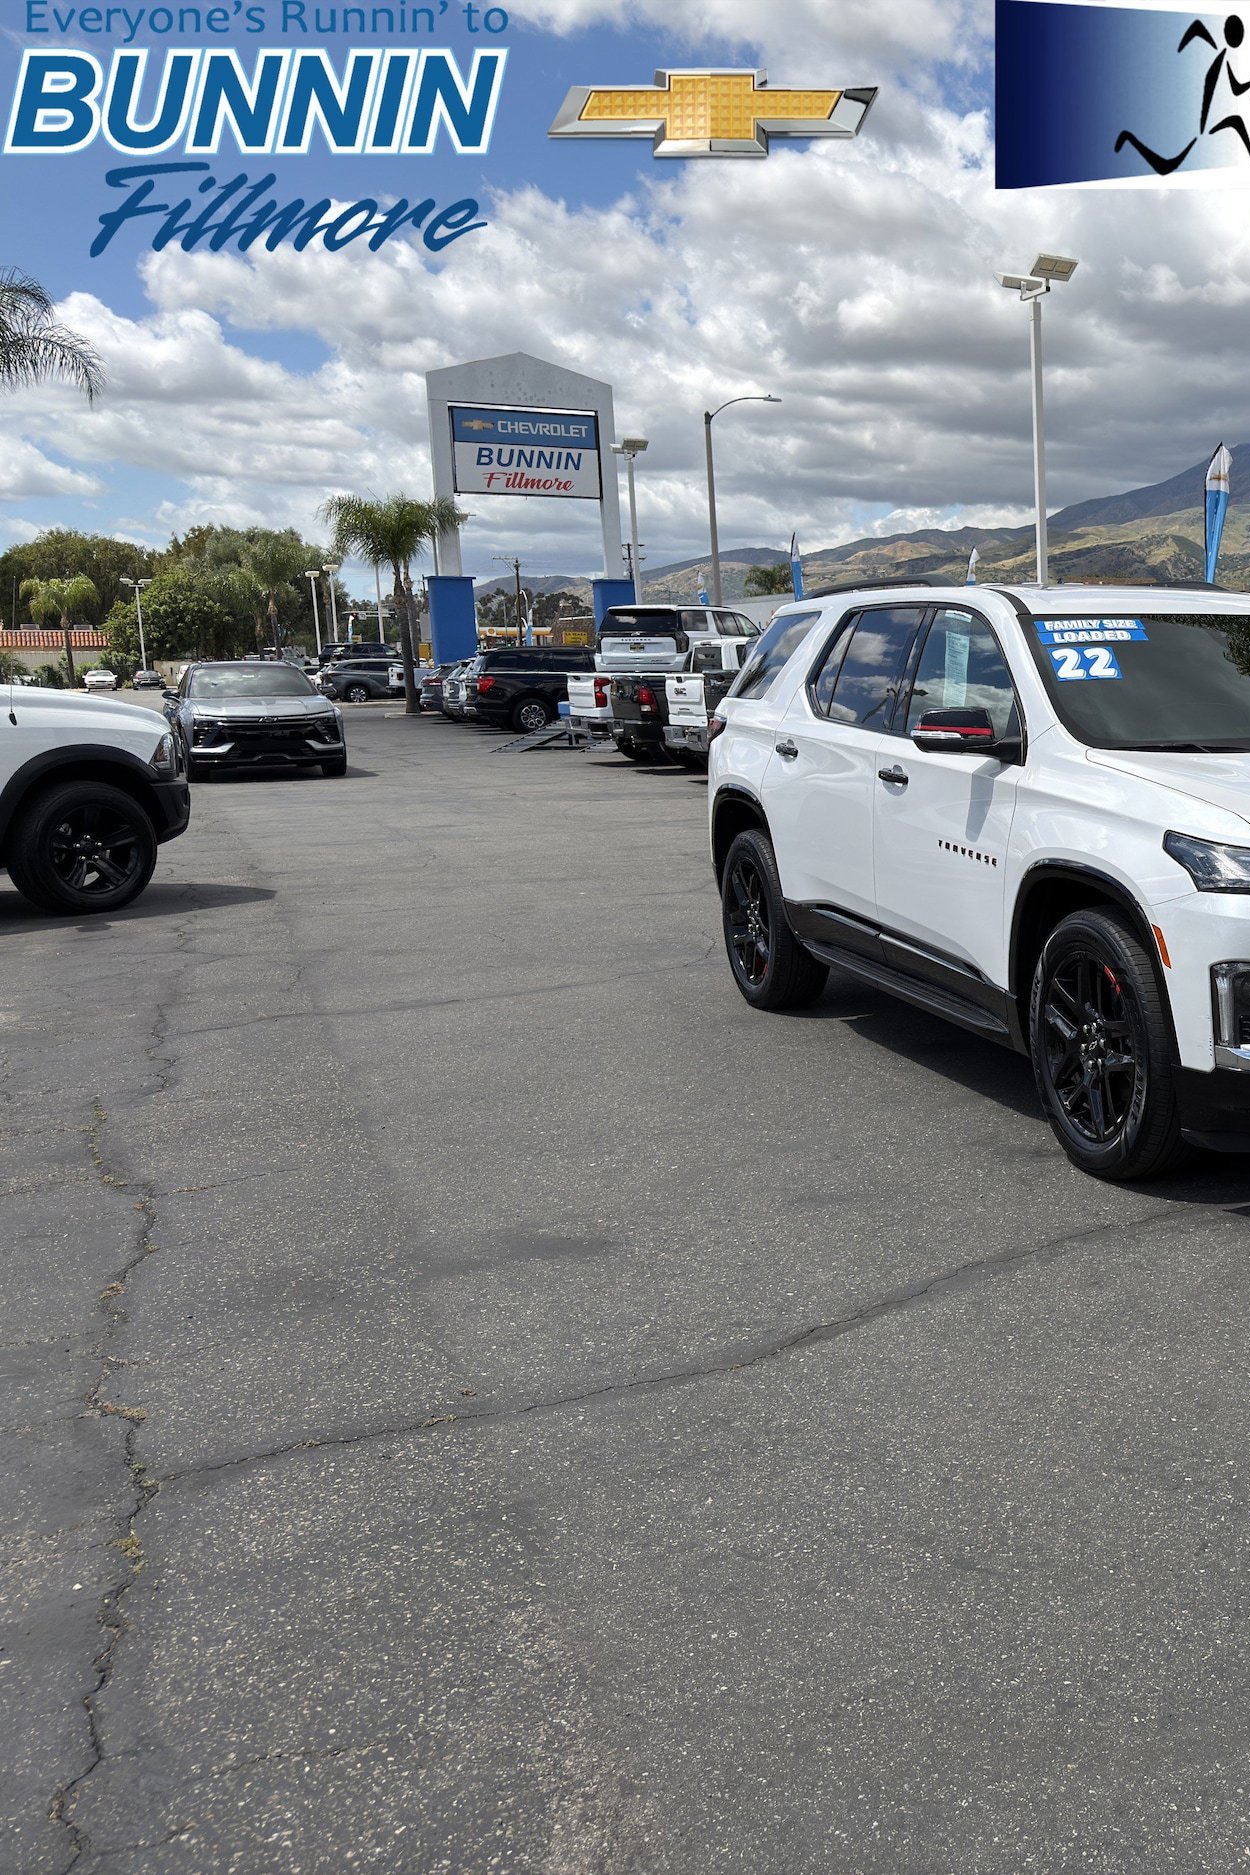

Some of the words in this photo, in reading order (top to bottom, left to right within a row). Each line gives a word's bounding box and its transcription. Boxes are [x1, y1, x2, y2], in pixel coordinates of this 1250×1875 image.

[497, 420, 588, 437] CHEVROLET
[476, 447, 582, 471] BUNNIN
[482, 472, 575, 492] Fillmore
[1044, 619, 1101, 631] FAMILY
[1102, 619, 1138, 629] SIZE
[1053, 630, 1131, 643] LOADED
[1052, 647, 1118, 679] 22
[938, 840, 997, 868] TRAVERSE
